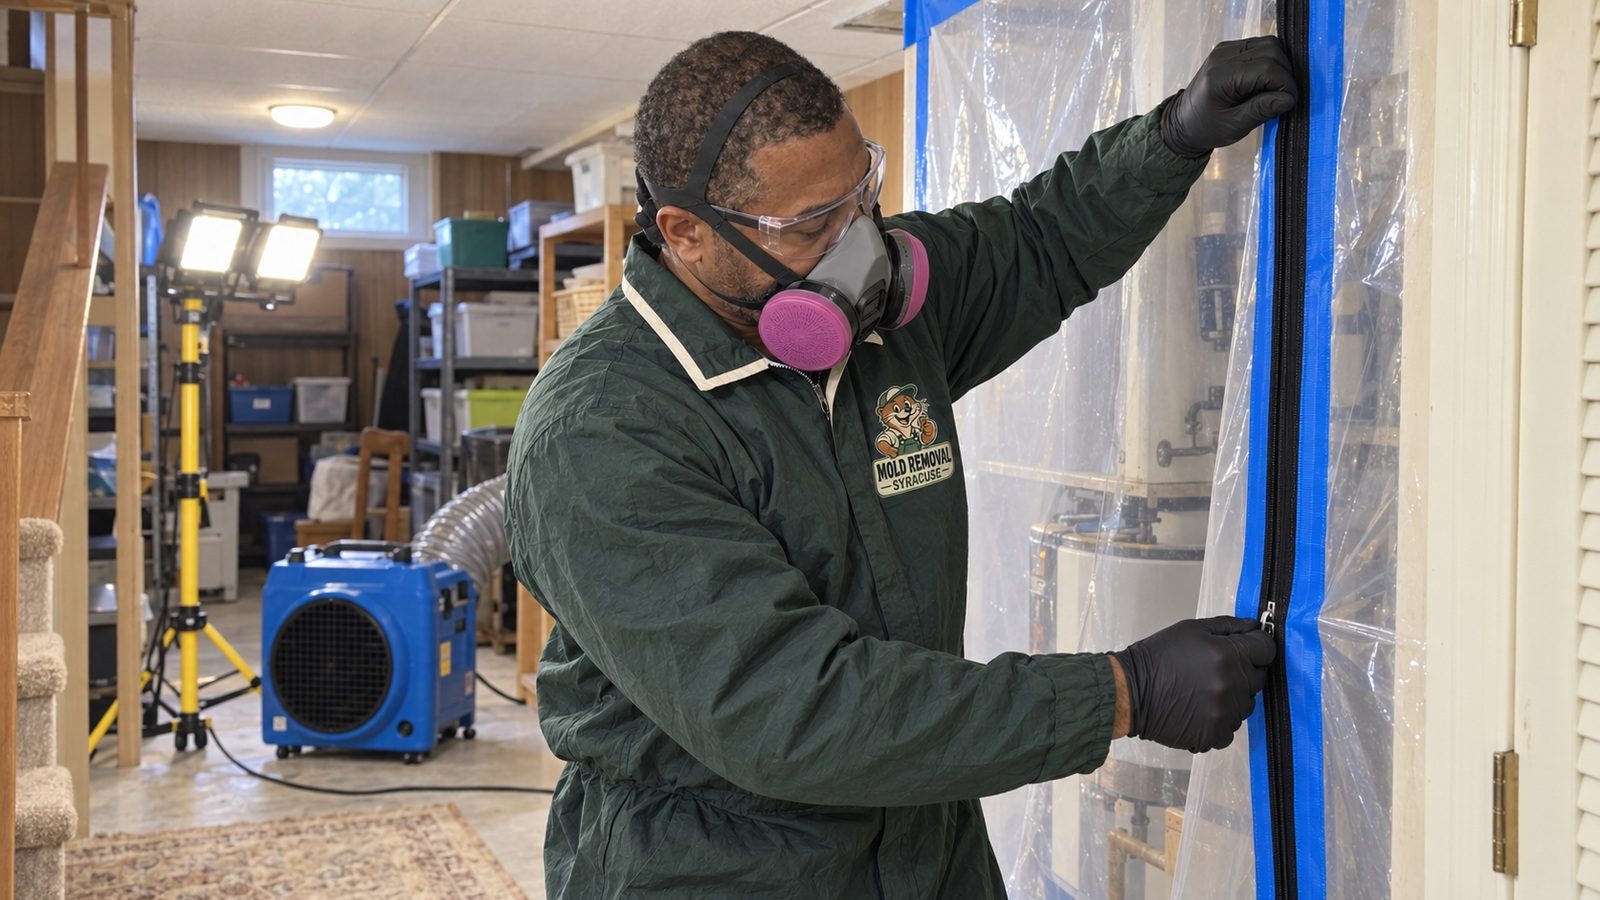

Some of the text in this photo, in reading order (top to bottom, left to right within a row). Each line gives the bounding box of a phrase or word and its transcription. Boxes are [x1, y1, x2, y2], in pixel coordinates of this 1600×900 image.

[876, 446, 952, 482] MOLD REMOVAL
[892, 467, 942, 490] SYRACUSE
